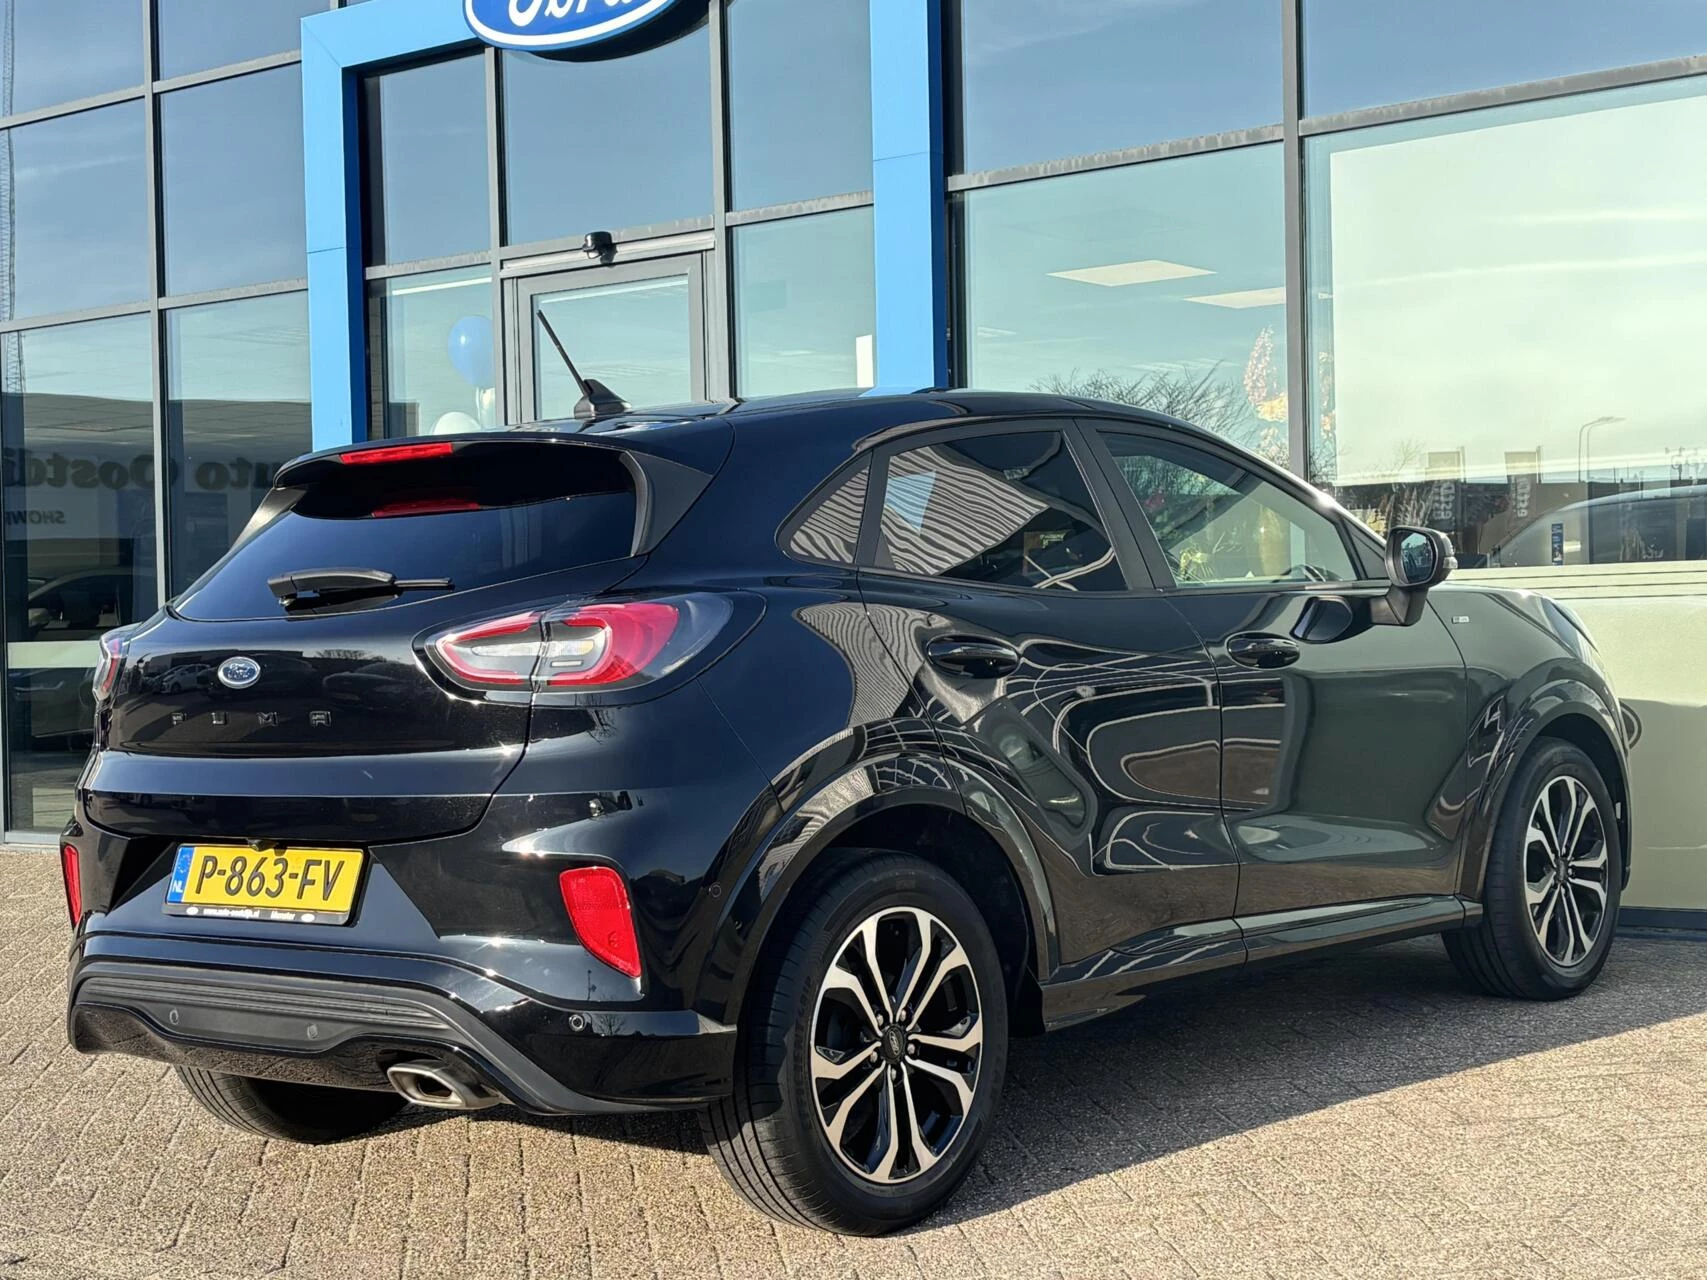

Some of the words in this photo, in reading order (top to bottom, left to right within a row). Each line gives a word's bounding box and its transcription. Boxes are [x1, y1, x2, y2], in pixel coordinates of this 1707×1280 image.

[508, 0, 632, 27] Fo
[172, 879, 184, 894] NL
[195, 855, 346, 901] P-863-FV
